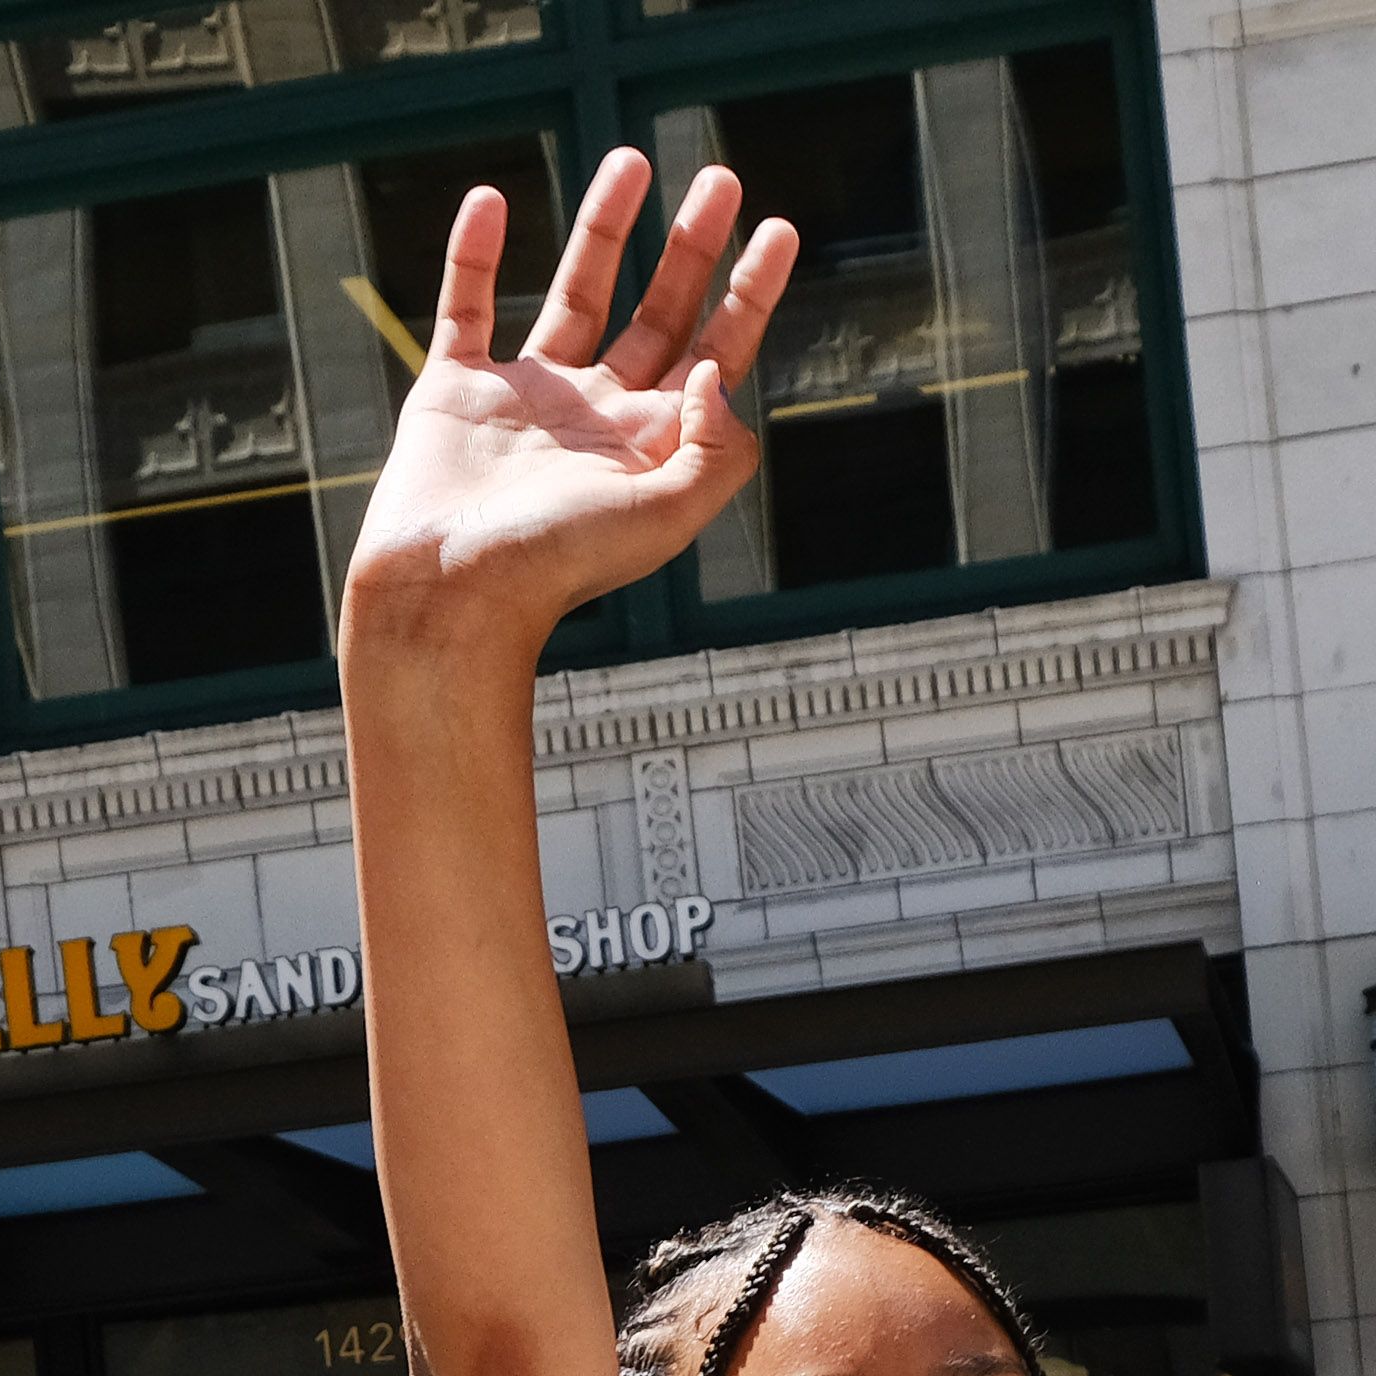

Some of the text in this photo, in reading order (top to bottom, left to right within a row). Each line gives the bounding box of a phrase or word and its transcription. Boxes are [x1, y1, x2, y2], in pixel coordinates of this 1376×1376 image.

[187, 943, 362, 1024] SAND
[546, 894, 715, 976] SHOP
[314, 1320, 405, 1369] 142
